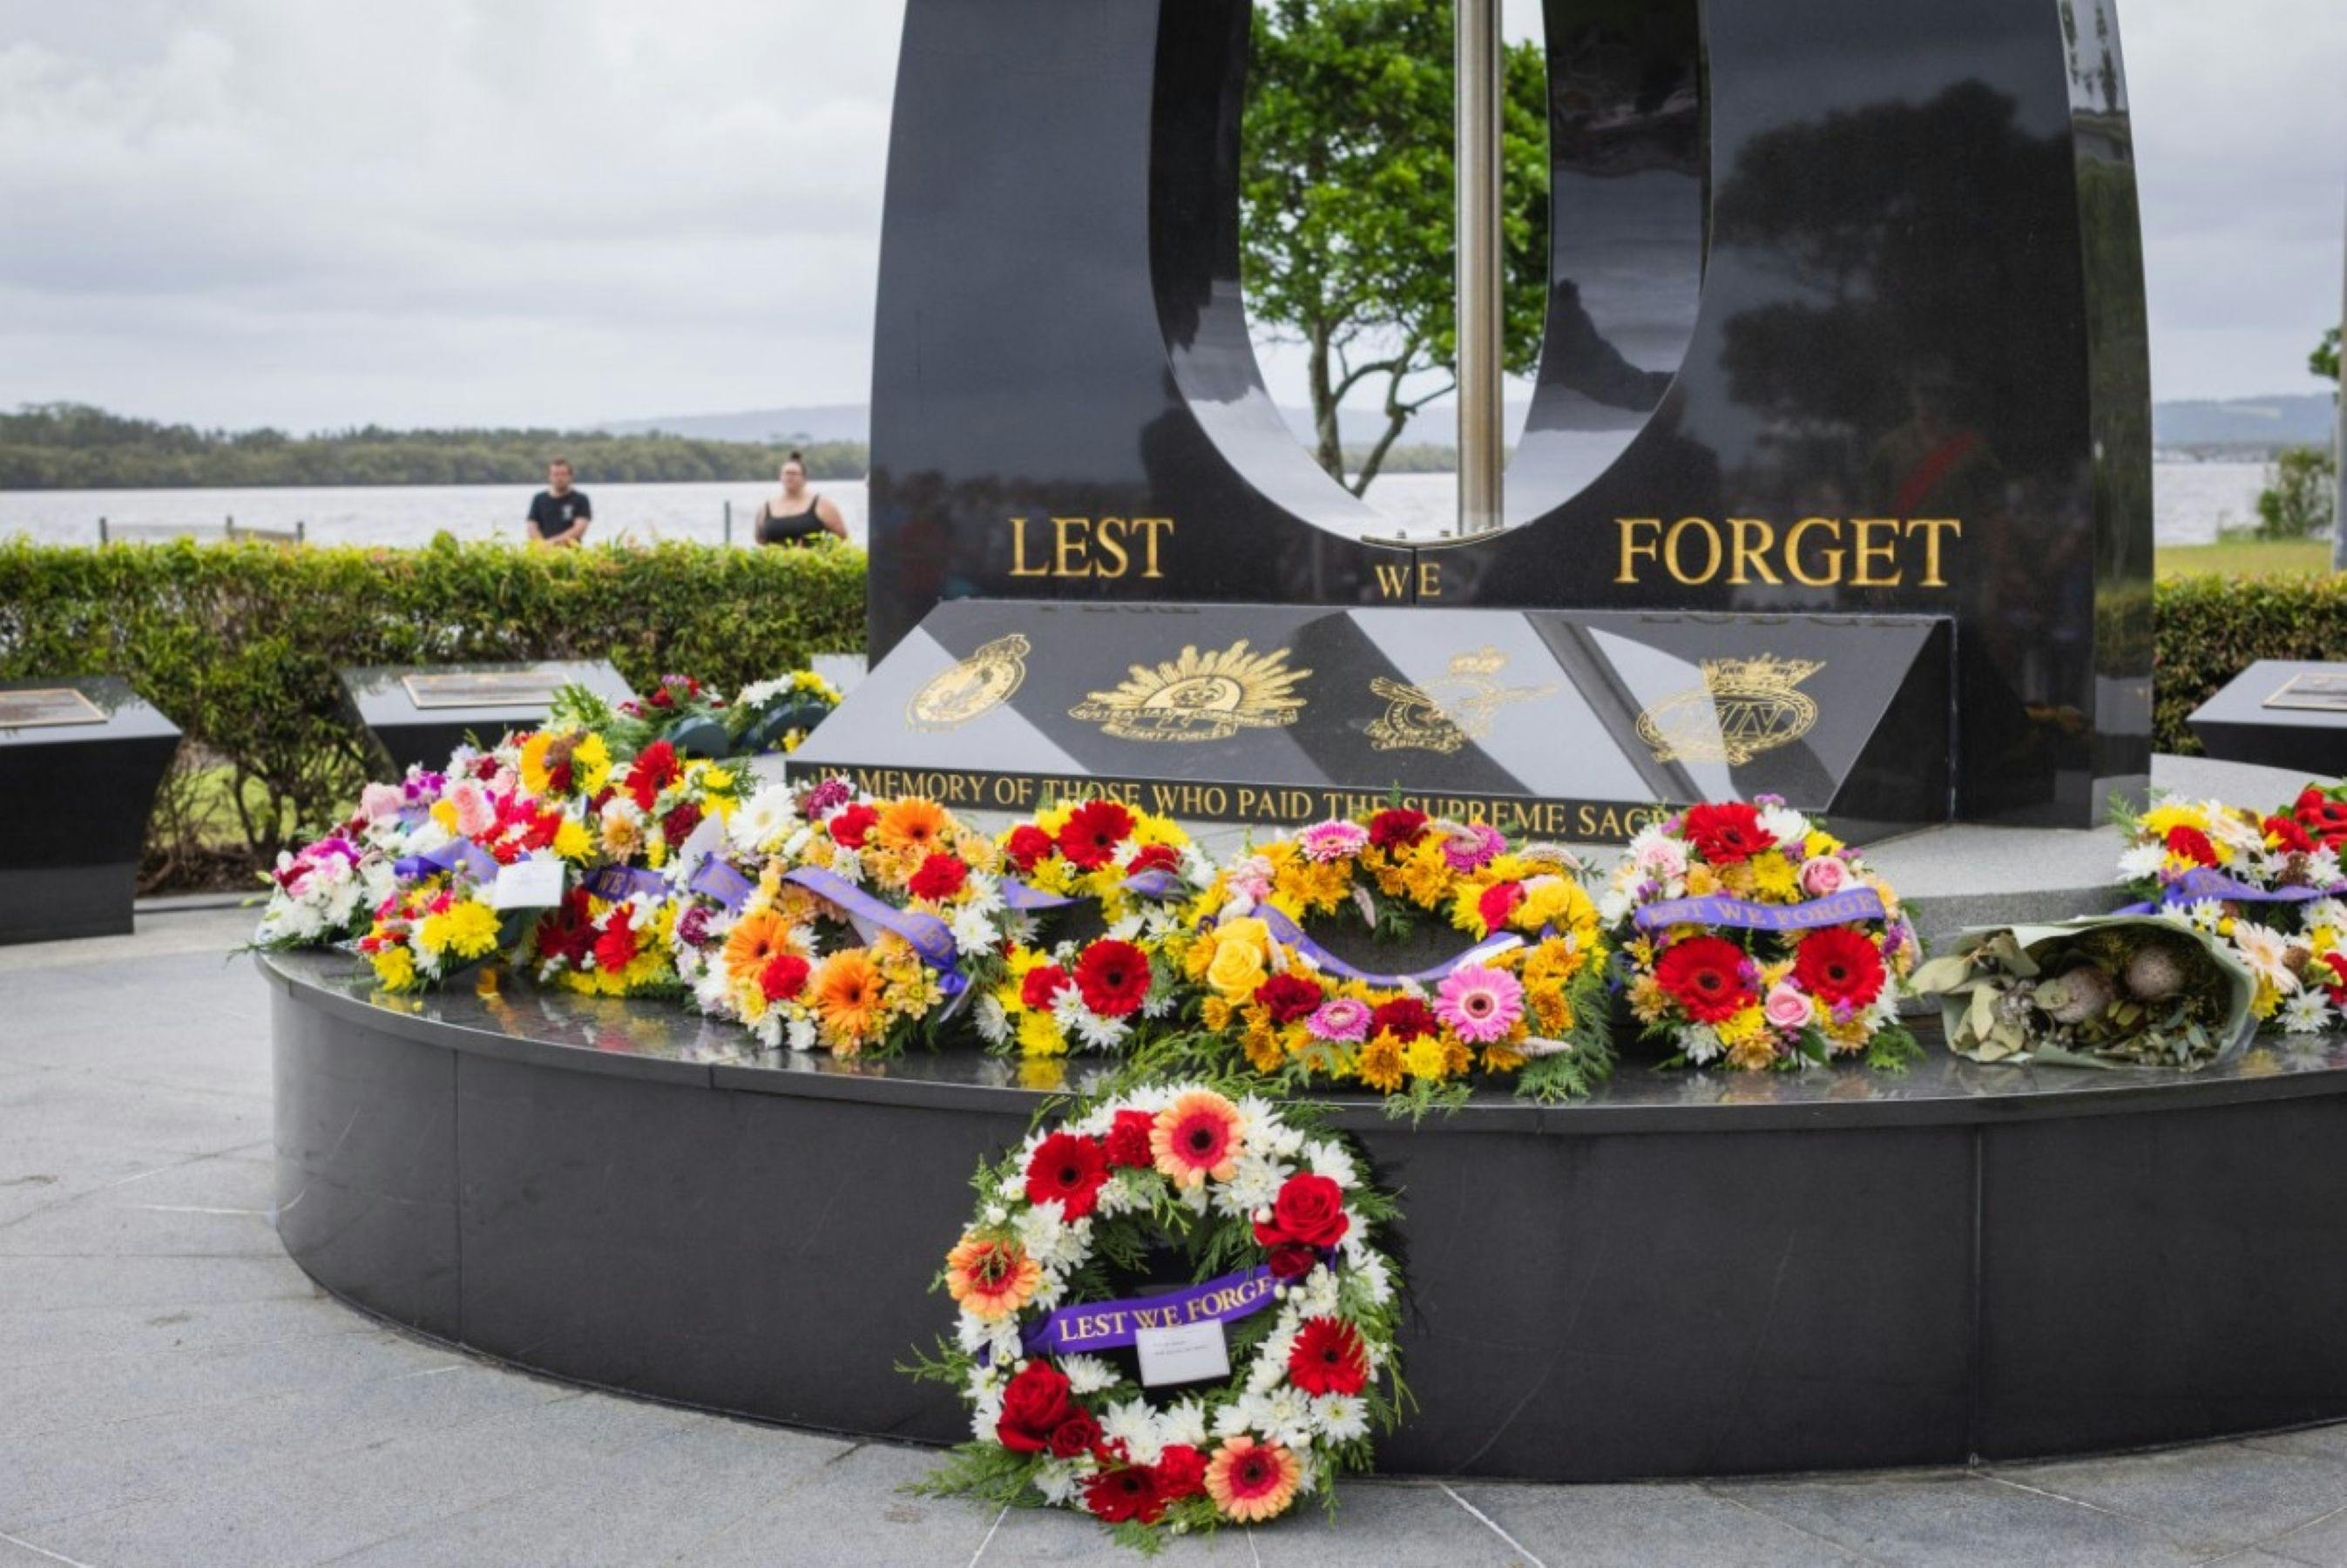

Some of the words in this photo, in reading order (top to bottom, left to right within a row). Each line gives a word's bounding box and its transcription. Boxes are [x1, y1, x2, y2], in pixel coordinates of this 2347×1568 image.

[1008, 517, 1174, 578] LEST
[1613, 517, 1962, 587] FORGET
[1375, 562, 1442, 598] WE
[856, 768, 988, 802] MEMORY
[994, 778, 1033, 805] OF
[1152, 786, 1227, 816] WHO
[1238, 790, 1314, 819] PAID
[1059, 1311, 1127, 1342] LEST
[1132, 1307, 1182, 1328] WE
